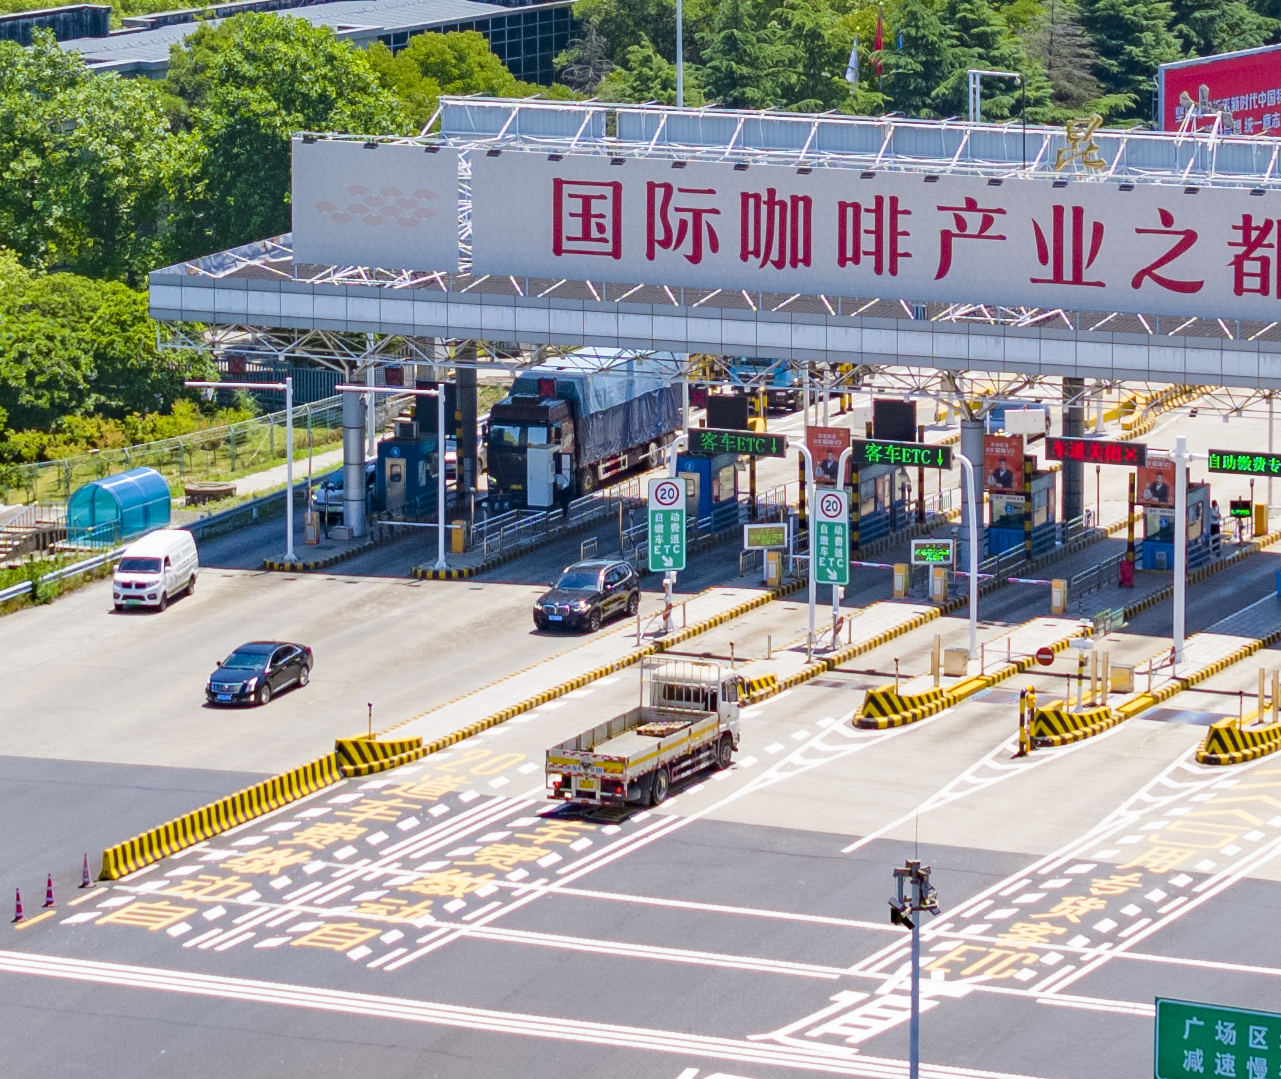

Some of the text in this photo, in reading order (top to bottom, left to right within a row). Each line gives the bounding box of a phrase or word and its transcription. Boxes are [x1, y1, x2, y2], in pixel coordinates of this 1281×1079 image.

[700, 431, 766, 454] 客车ETC
[865, 443, 931, 466] 客车ETC
[659, 487, 675, 500] 20
[824, 499, 839, 513] 20
[654, 512, 680, 522] 自动
[820, 523, 843, 535] 自动
[654, 534, 680, 545] 车道
[653, 544, 681, 555] ETC
[819, 547, 843, 558] 车道
[819, 557, 844, 568] ETC
